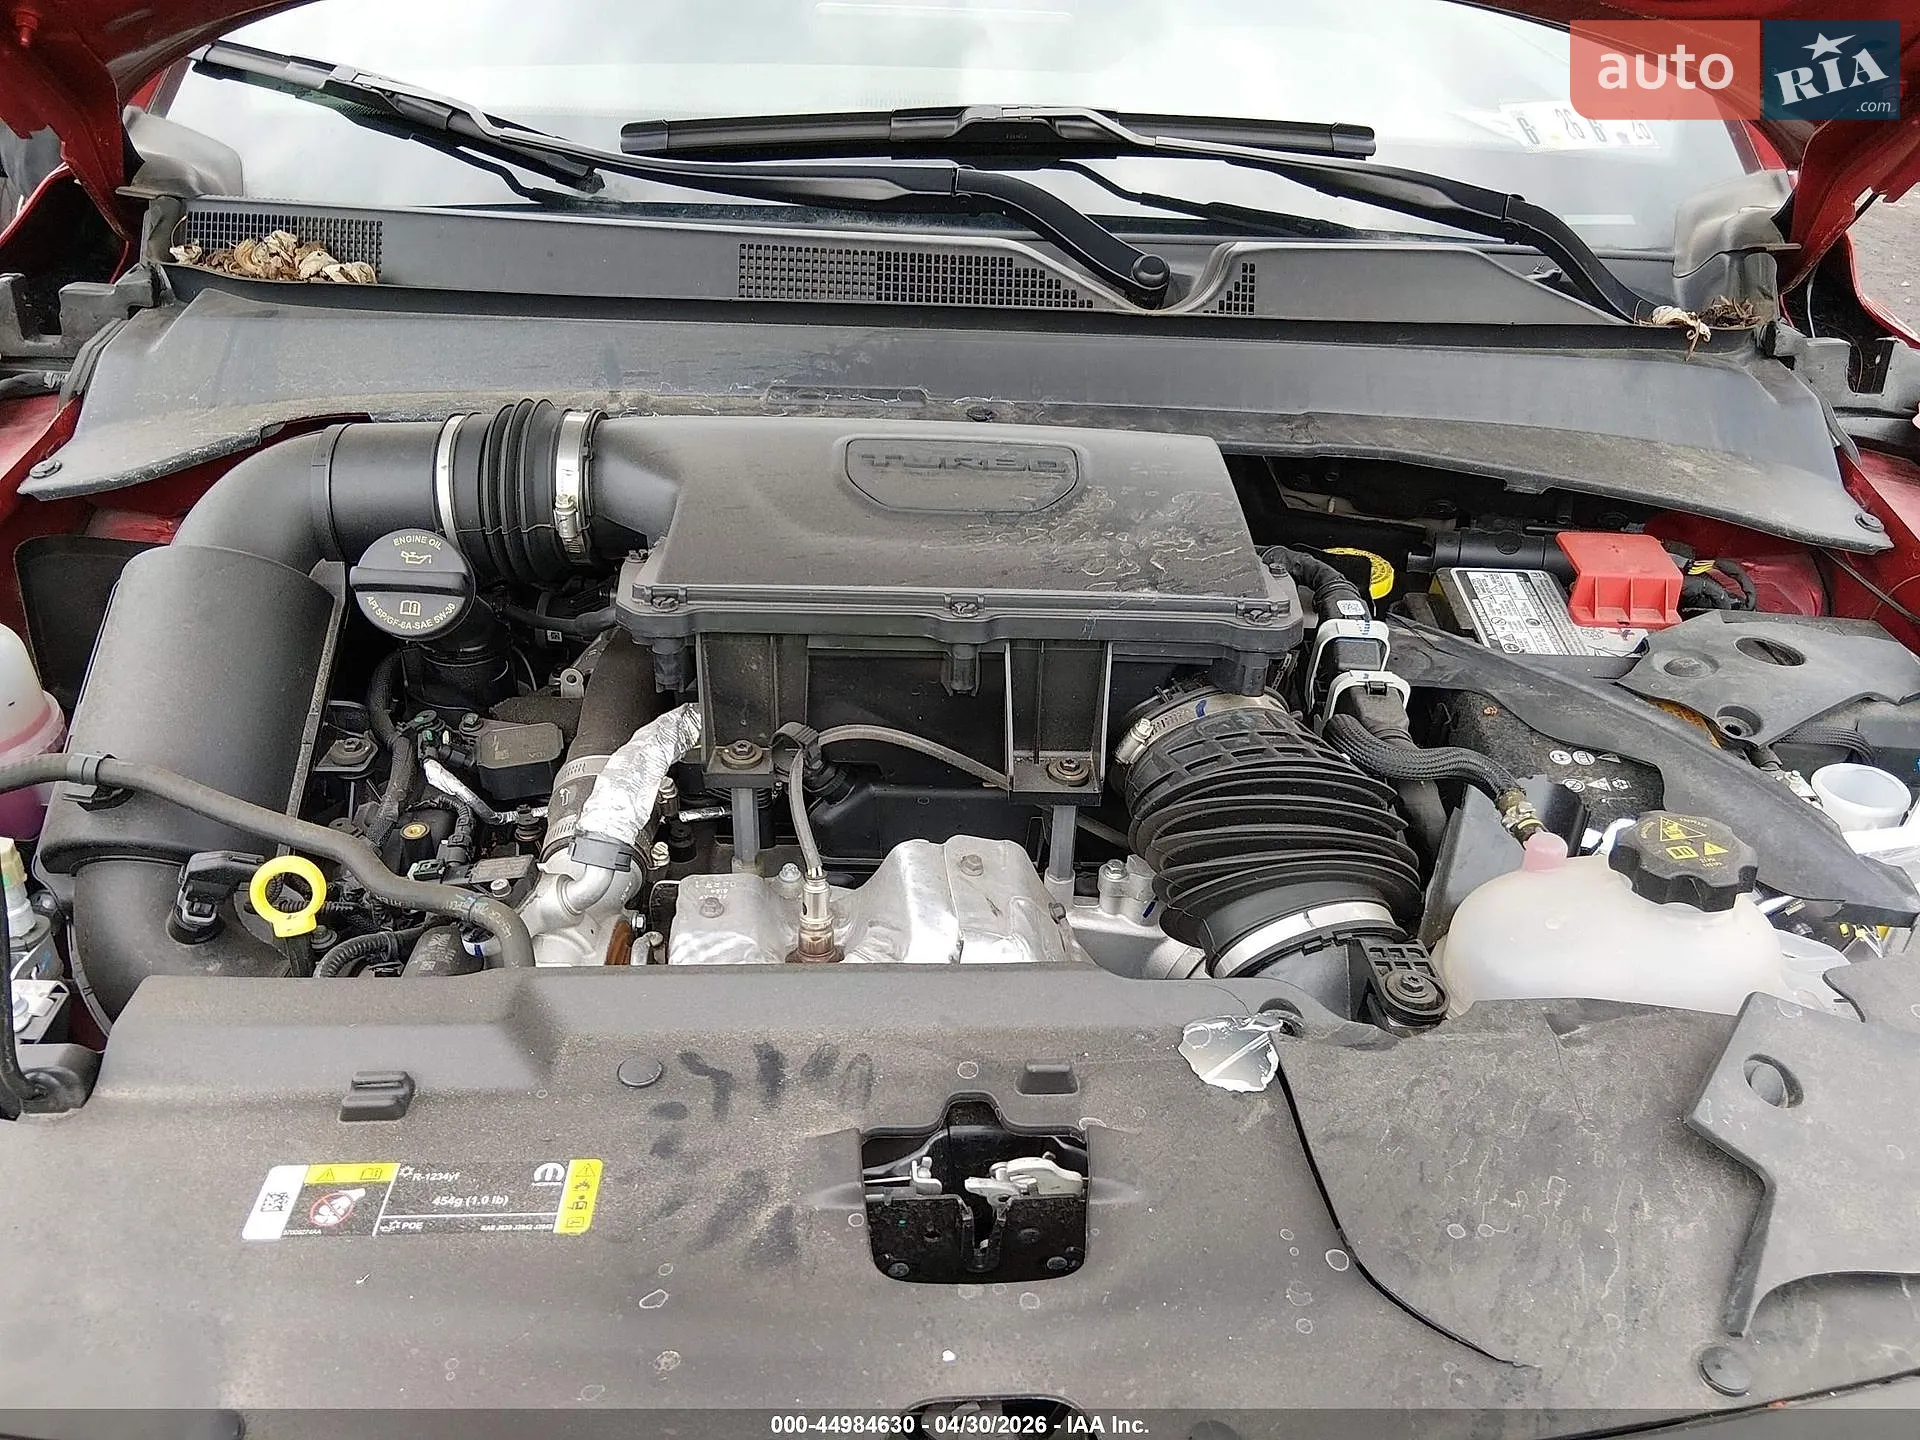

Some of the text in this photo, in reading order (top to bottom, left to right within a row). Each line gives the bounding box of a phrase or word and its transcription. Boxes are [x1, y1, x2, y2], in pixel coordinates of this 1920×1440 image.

[393, 535, 442, 550] ENGINE OIL
[366, 596, 379, 610] API
[434, 602, 456, 624] 5W-30
[412, 1172, 460, 1182] R-1234yf
[432, 1194, 509, 1207] 454g (1.0 lb)
[401, 1221, 423, 1230] POE
